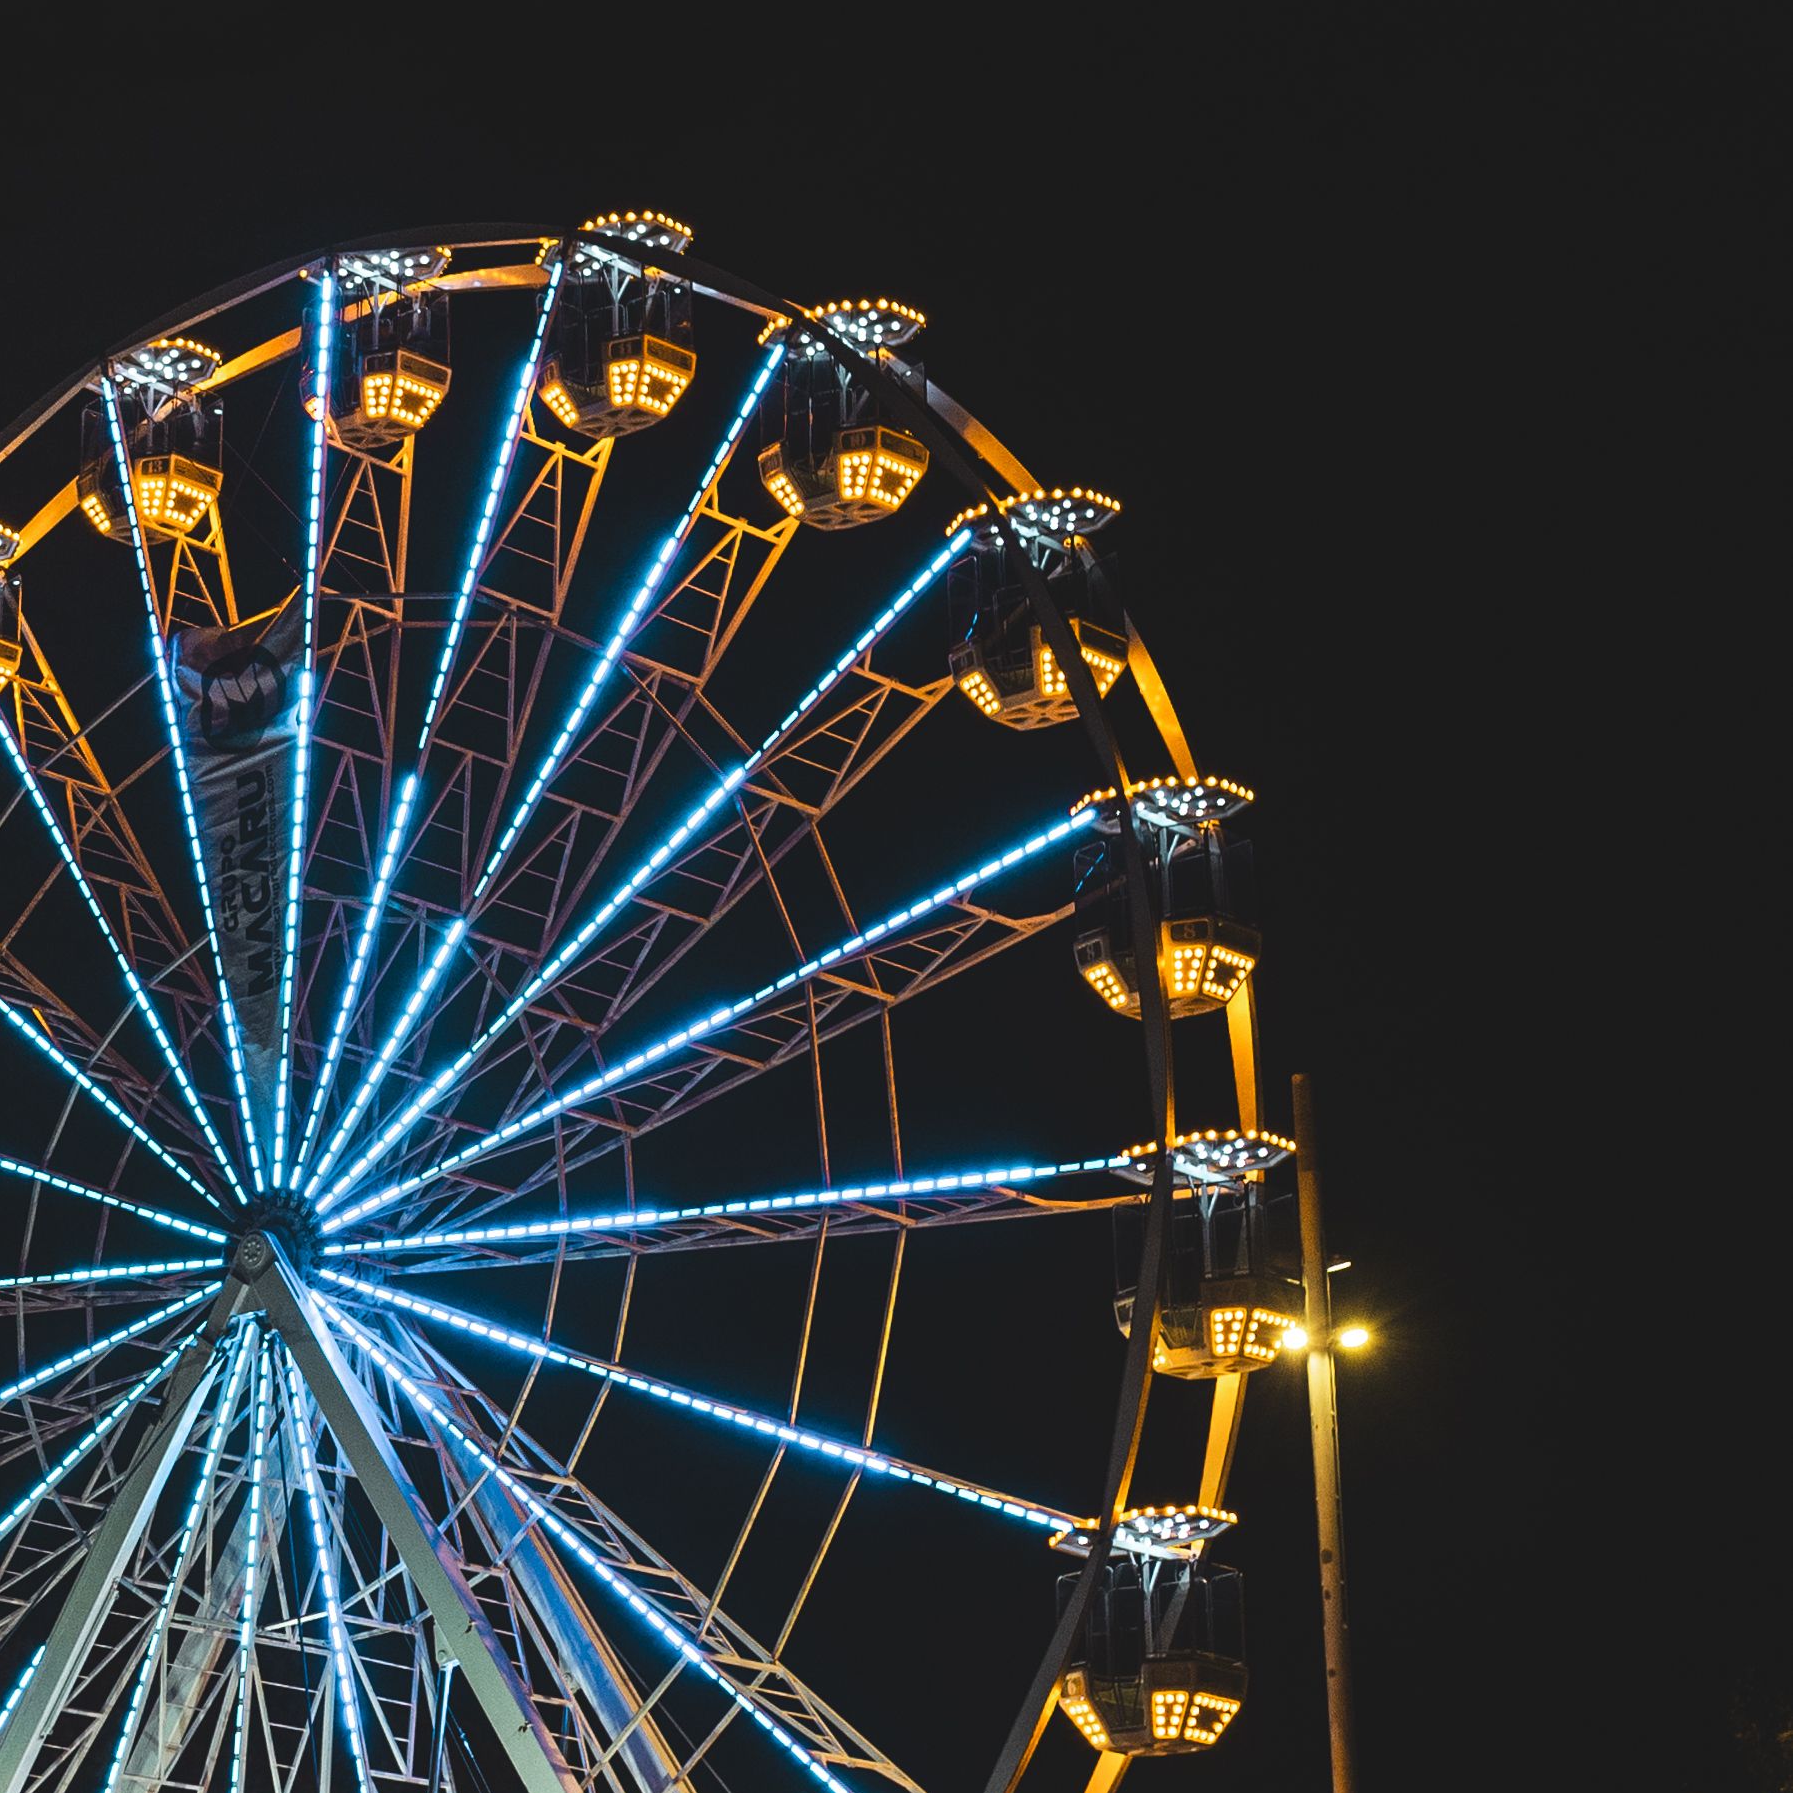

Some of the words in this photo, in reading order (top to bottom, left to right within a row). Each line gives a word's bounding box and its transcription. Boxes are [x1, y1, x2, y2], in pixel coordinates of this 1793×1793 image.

[849, 432, 865, 445] 10
[220, 834, 238, 932] GRUPO
[237, 770, 274, 996] MACARU
[1183, 925, 1196, 938] 8
